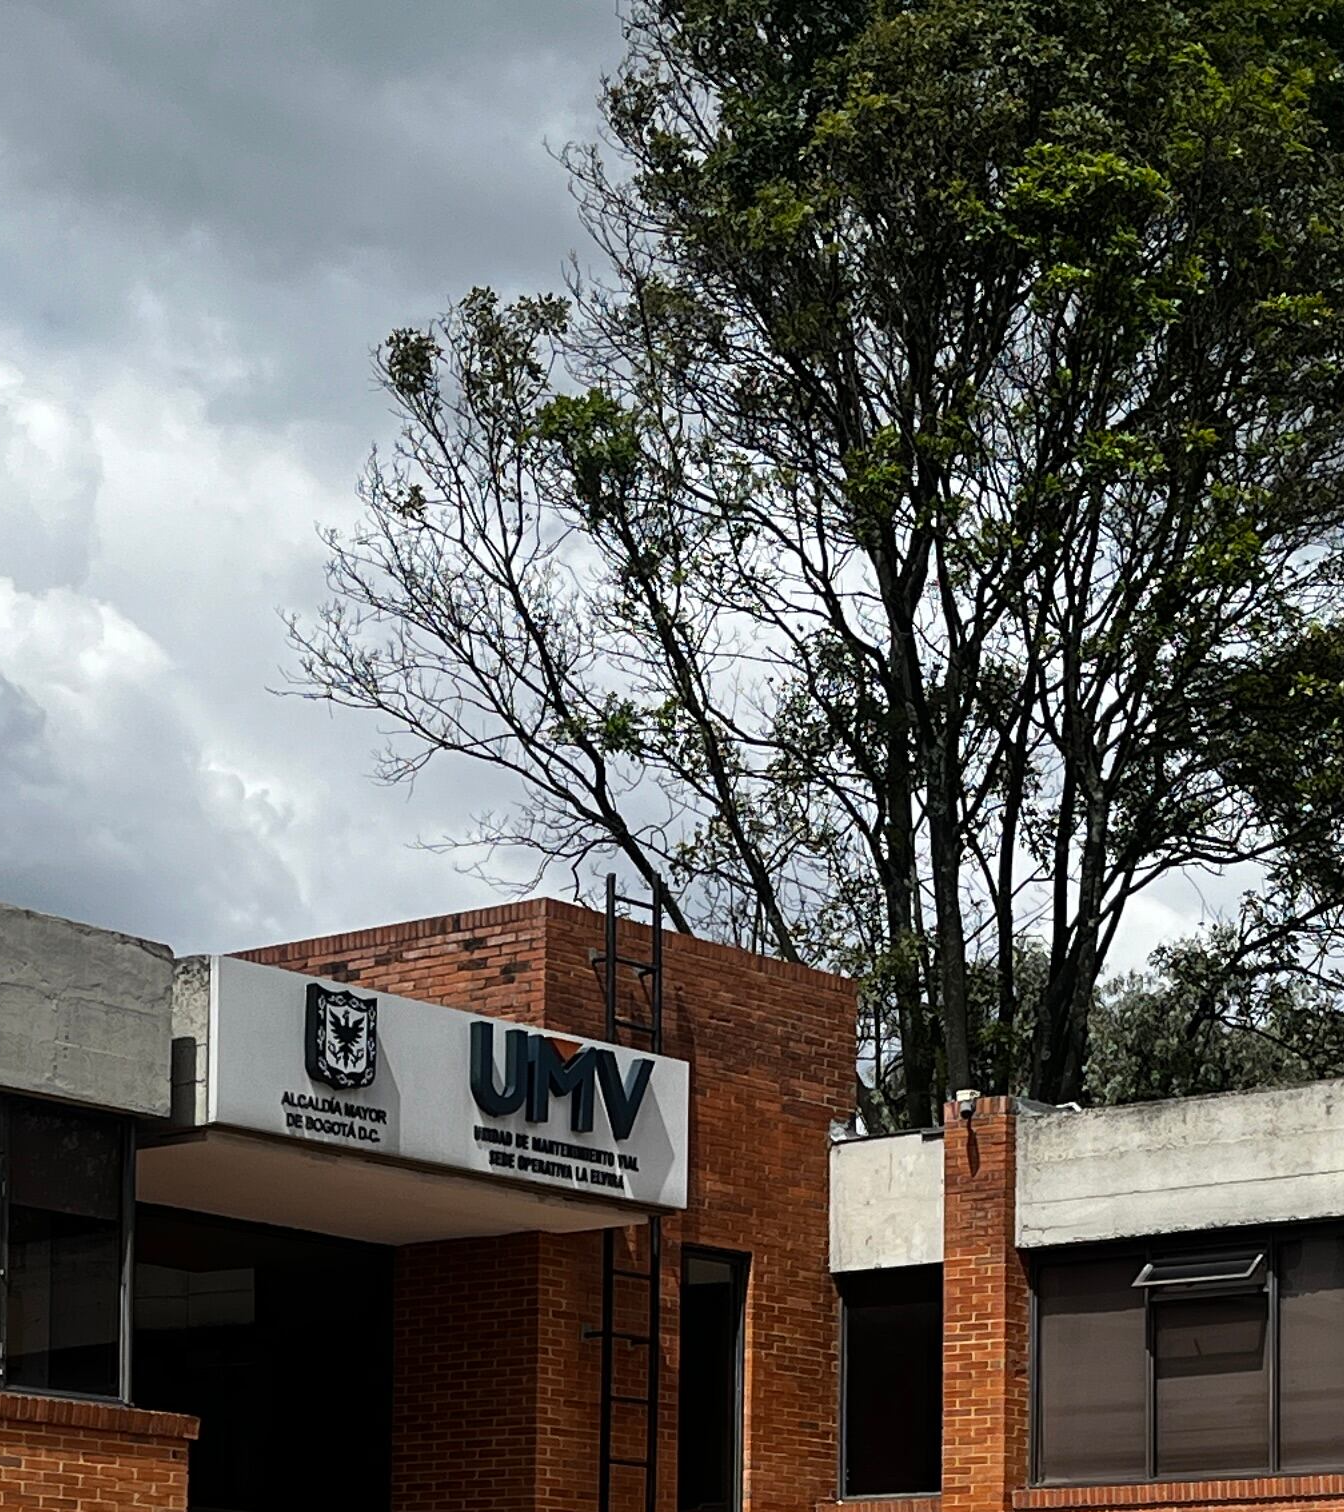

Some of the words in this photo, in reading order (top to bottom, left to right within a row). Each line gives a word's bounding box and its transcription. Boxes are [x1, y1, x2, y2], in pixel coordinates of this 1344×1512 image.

[470, 1021, 655, 1142] UMV
[281, 1091, 342, 1117] ALCALDÍA
[344, 1102, 387, 1125] MAYOR
[286, 1112, 303, 1129] DE
[305, 1116, 356, 1139] BOGOTÁ
[474, 1125, 513, 1147] UNIDAD
[515, 1133, 529, 1150] DE
[531, 1136, 615, 1167] MANTENIMIENTO
[617, 1153, 639, 1172] VIAL
[489, 1150, 515, 1168] SEDE
[517, 1155, 573, 1180] OPERATIVA
[575, 1165, 588, 1182] LA
